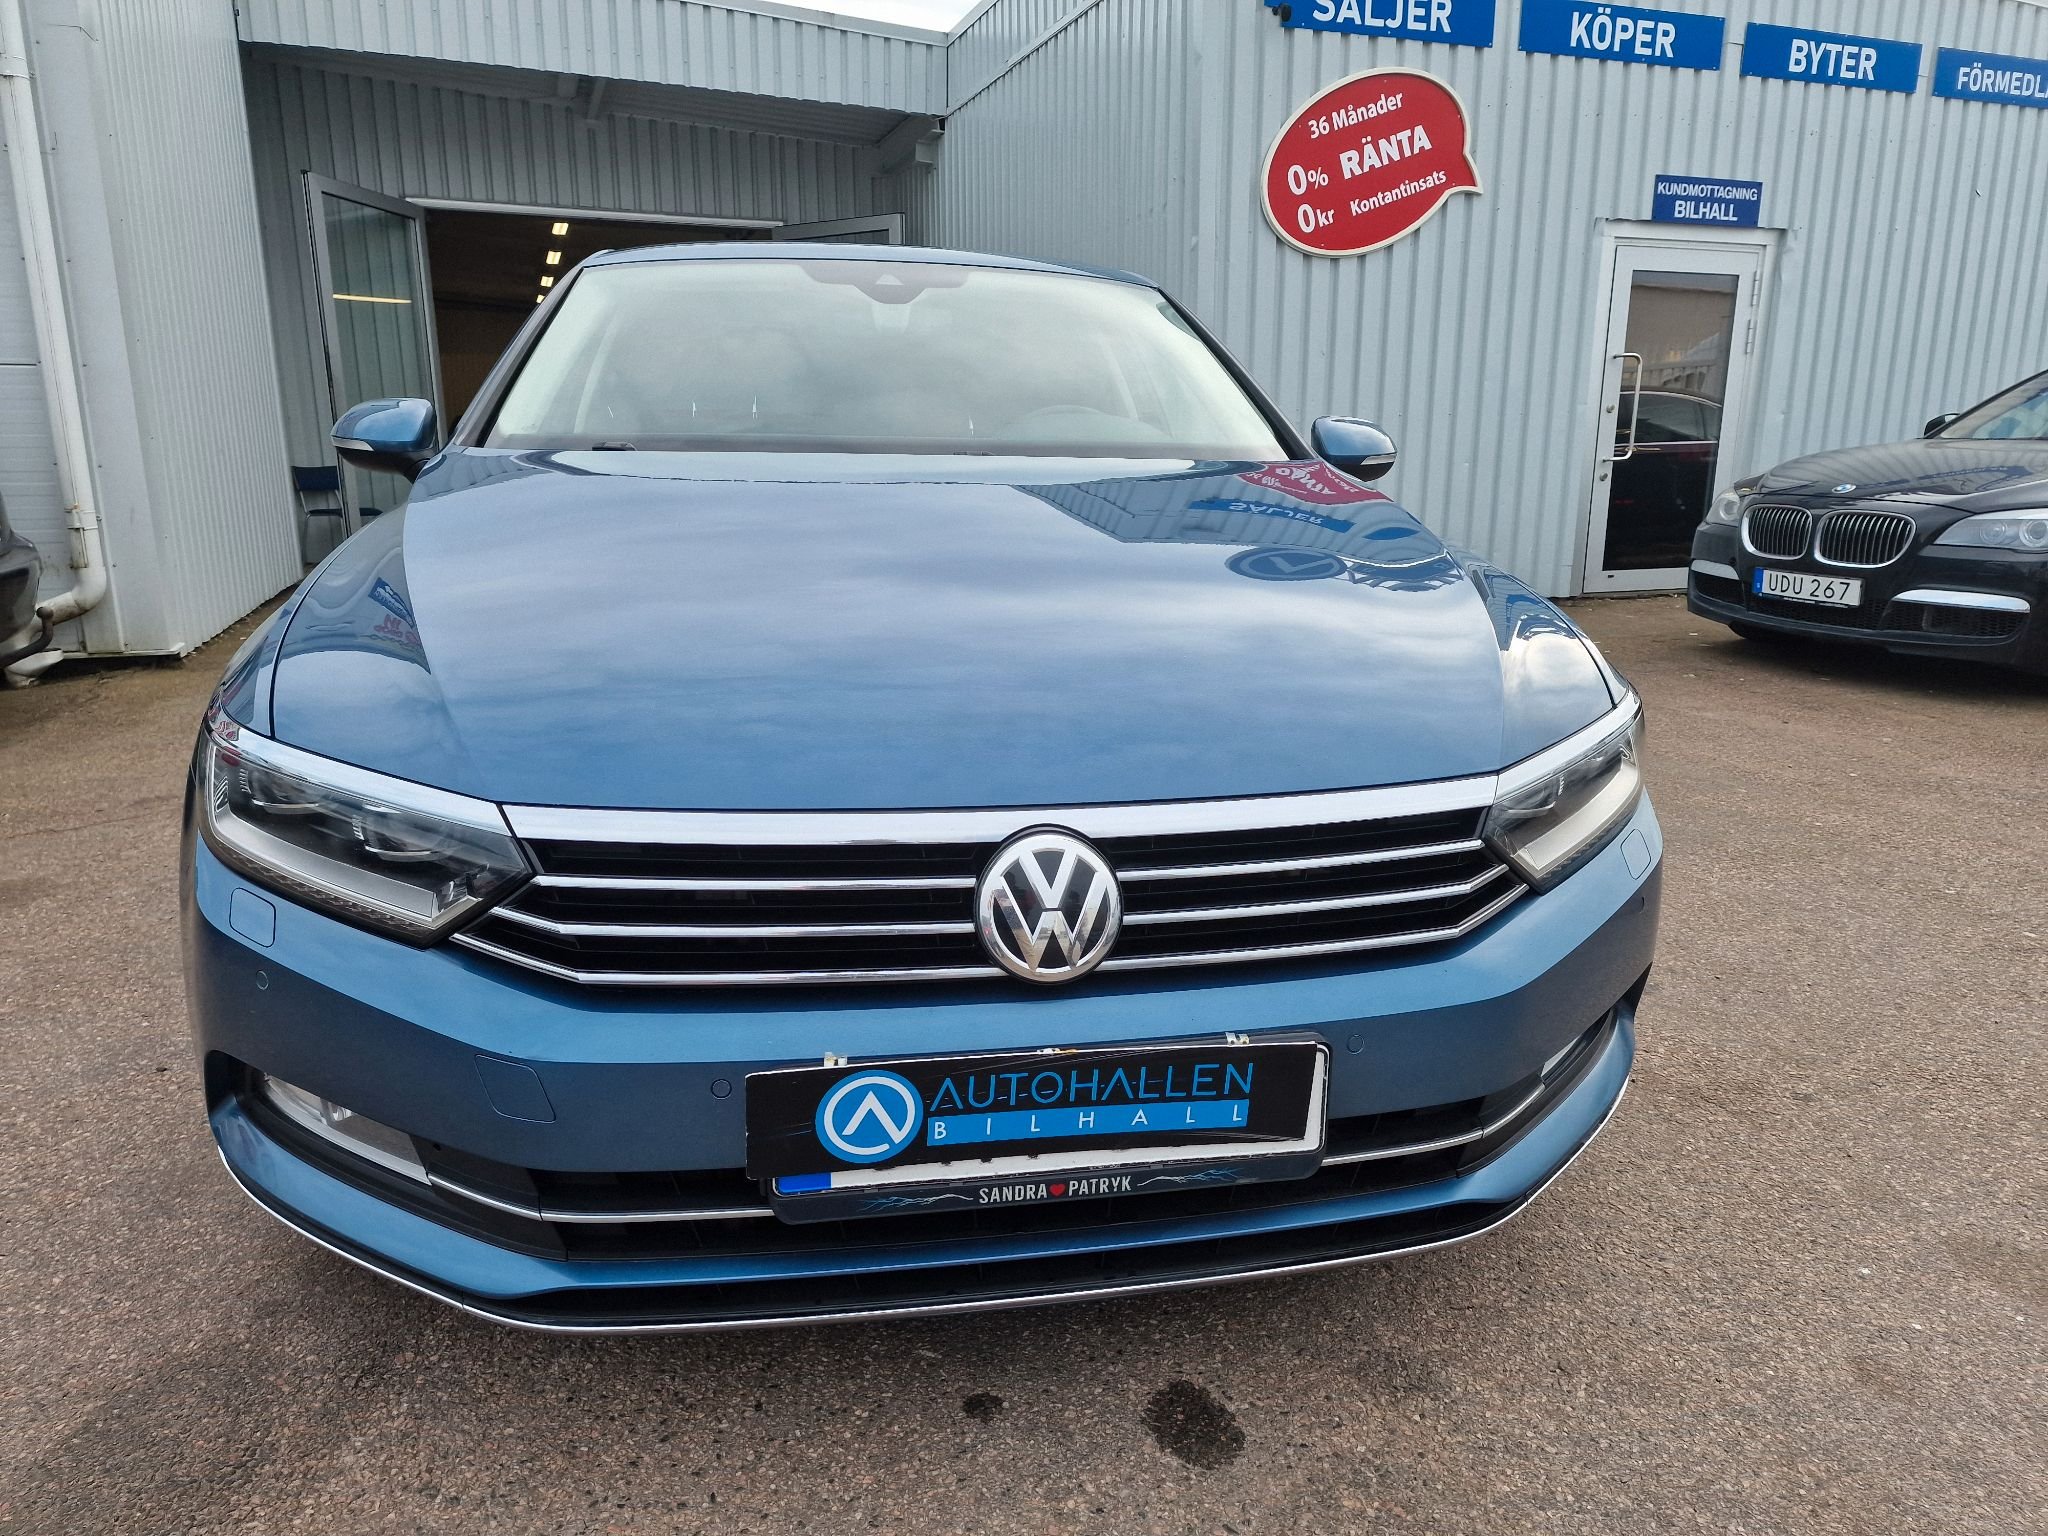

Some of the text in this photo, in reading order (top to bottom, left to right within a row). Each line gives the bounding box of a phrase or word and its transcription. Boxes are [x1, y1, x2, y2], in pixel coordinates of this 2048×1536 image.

[1570, 7, 1676, 58] KÖPER
[1788, 38, 1877, 81] BYTER
[1957, 62, 2048, 98] FÖRMEDL
[1308, 92, 1404, 139] 36 Månader
[1287, 125, 1433, 196] 0% RÄNTA
[1350, 170, 1447, 217] Kontantinsats
[1657, 182, 1758, 201] KUNDMOTTAGNING
[1673, 200, 1738, 221] BILHALL
[1768, 573, 1851, 601] UDU 267
[929, 1062, 1254, 1112] AUTOHALLEN
[933, 1104, 1242, 1140] BILHALL
[979, 1175, 1133, 1204] SANDRA PATRYK
